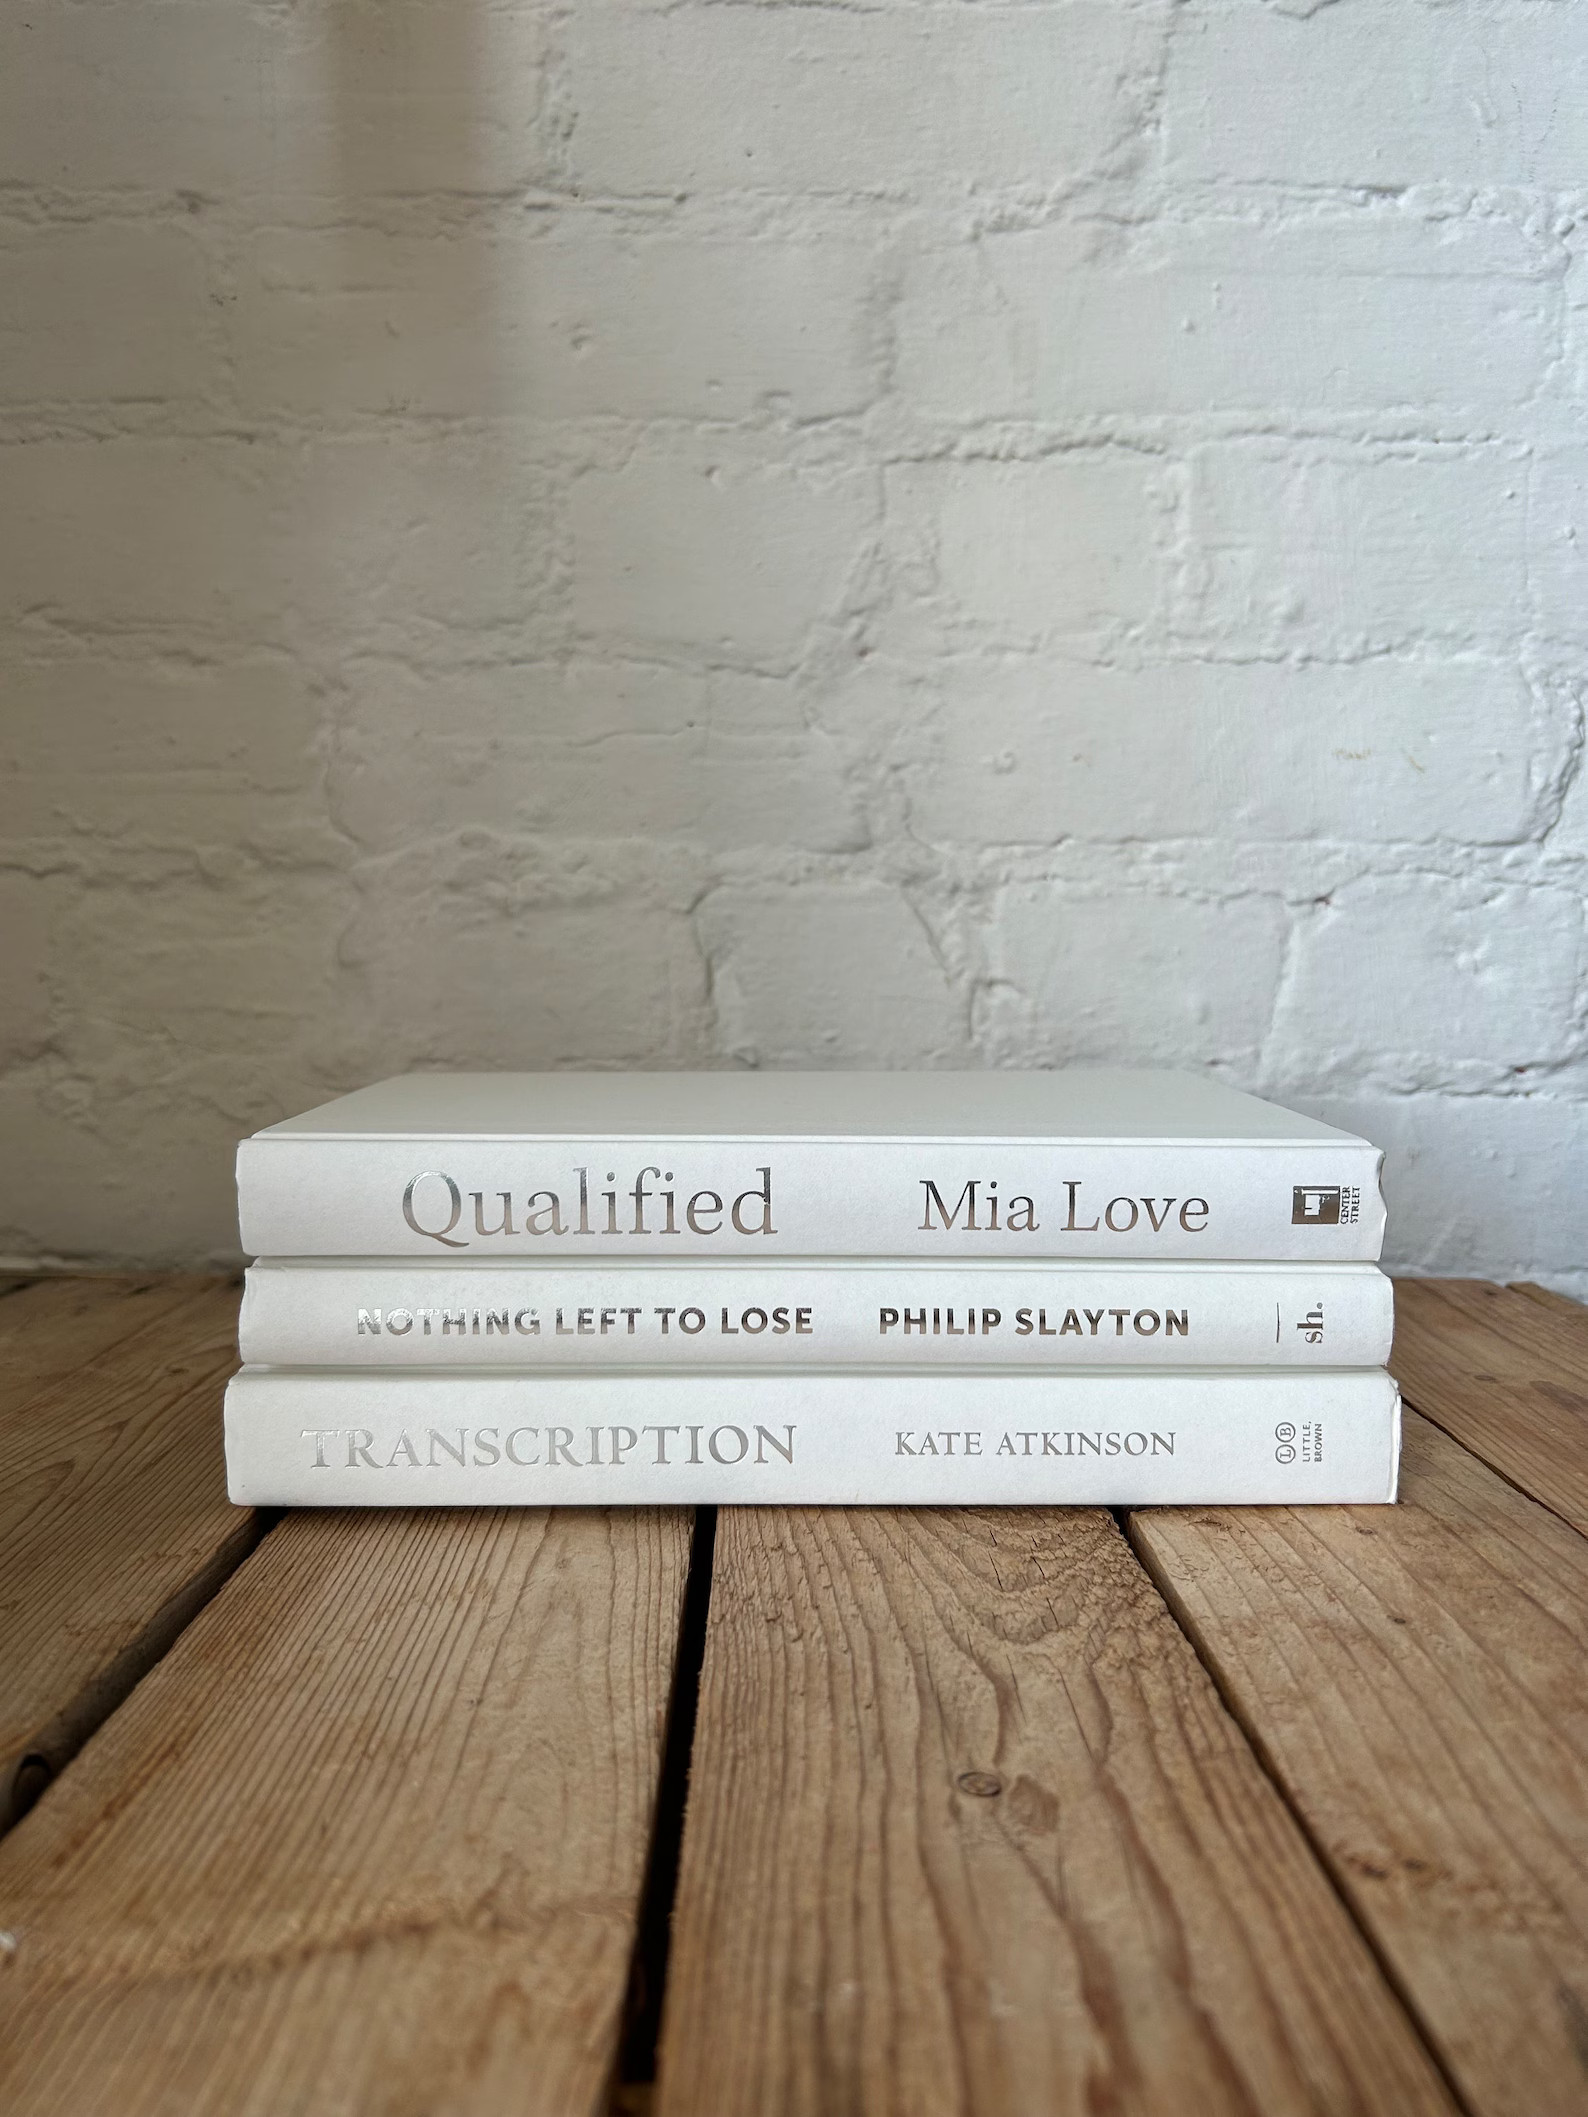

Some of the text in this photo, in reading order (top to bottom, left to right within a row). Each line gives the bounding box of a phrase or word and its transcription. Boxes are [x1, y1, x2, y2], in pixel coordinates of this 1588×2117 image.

[403, 1166, 778, 1248] Qualified
[918, 1180, 1211, 1233] Mia Love
[1340, 1186, 1350, 1224] CENTER
[1350, 1187, 1360, 1224] STREET
[357, 1306, 814, 1336] NOTHING LEFT TO LOSE
[879, 1308, 1190, 1336] PHILIP SLAYTON
[300, 1424, 797, 1470] TRANSCRIPTION
[895, 1431, 1177, 1457] KATE ATKINSON
[1314, 1423, 1322, 1462] BROWN
